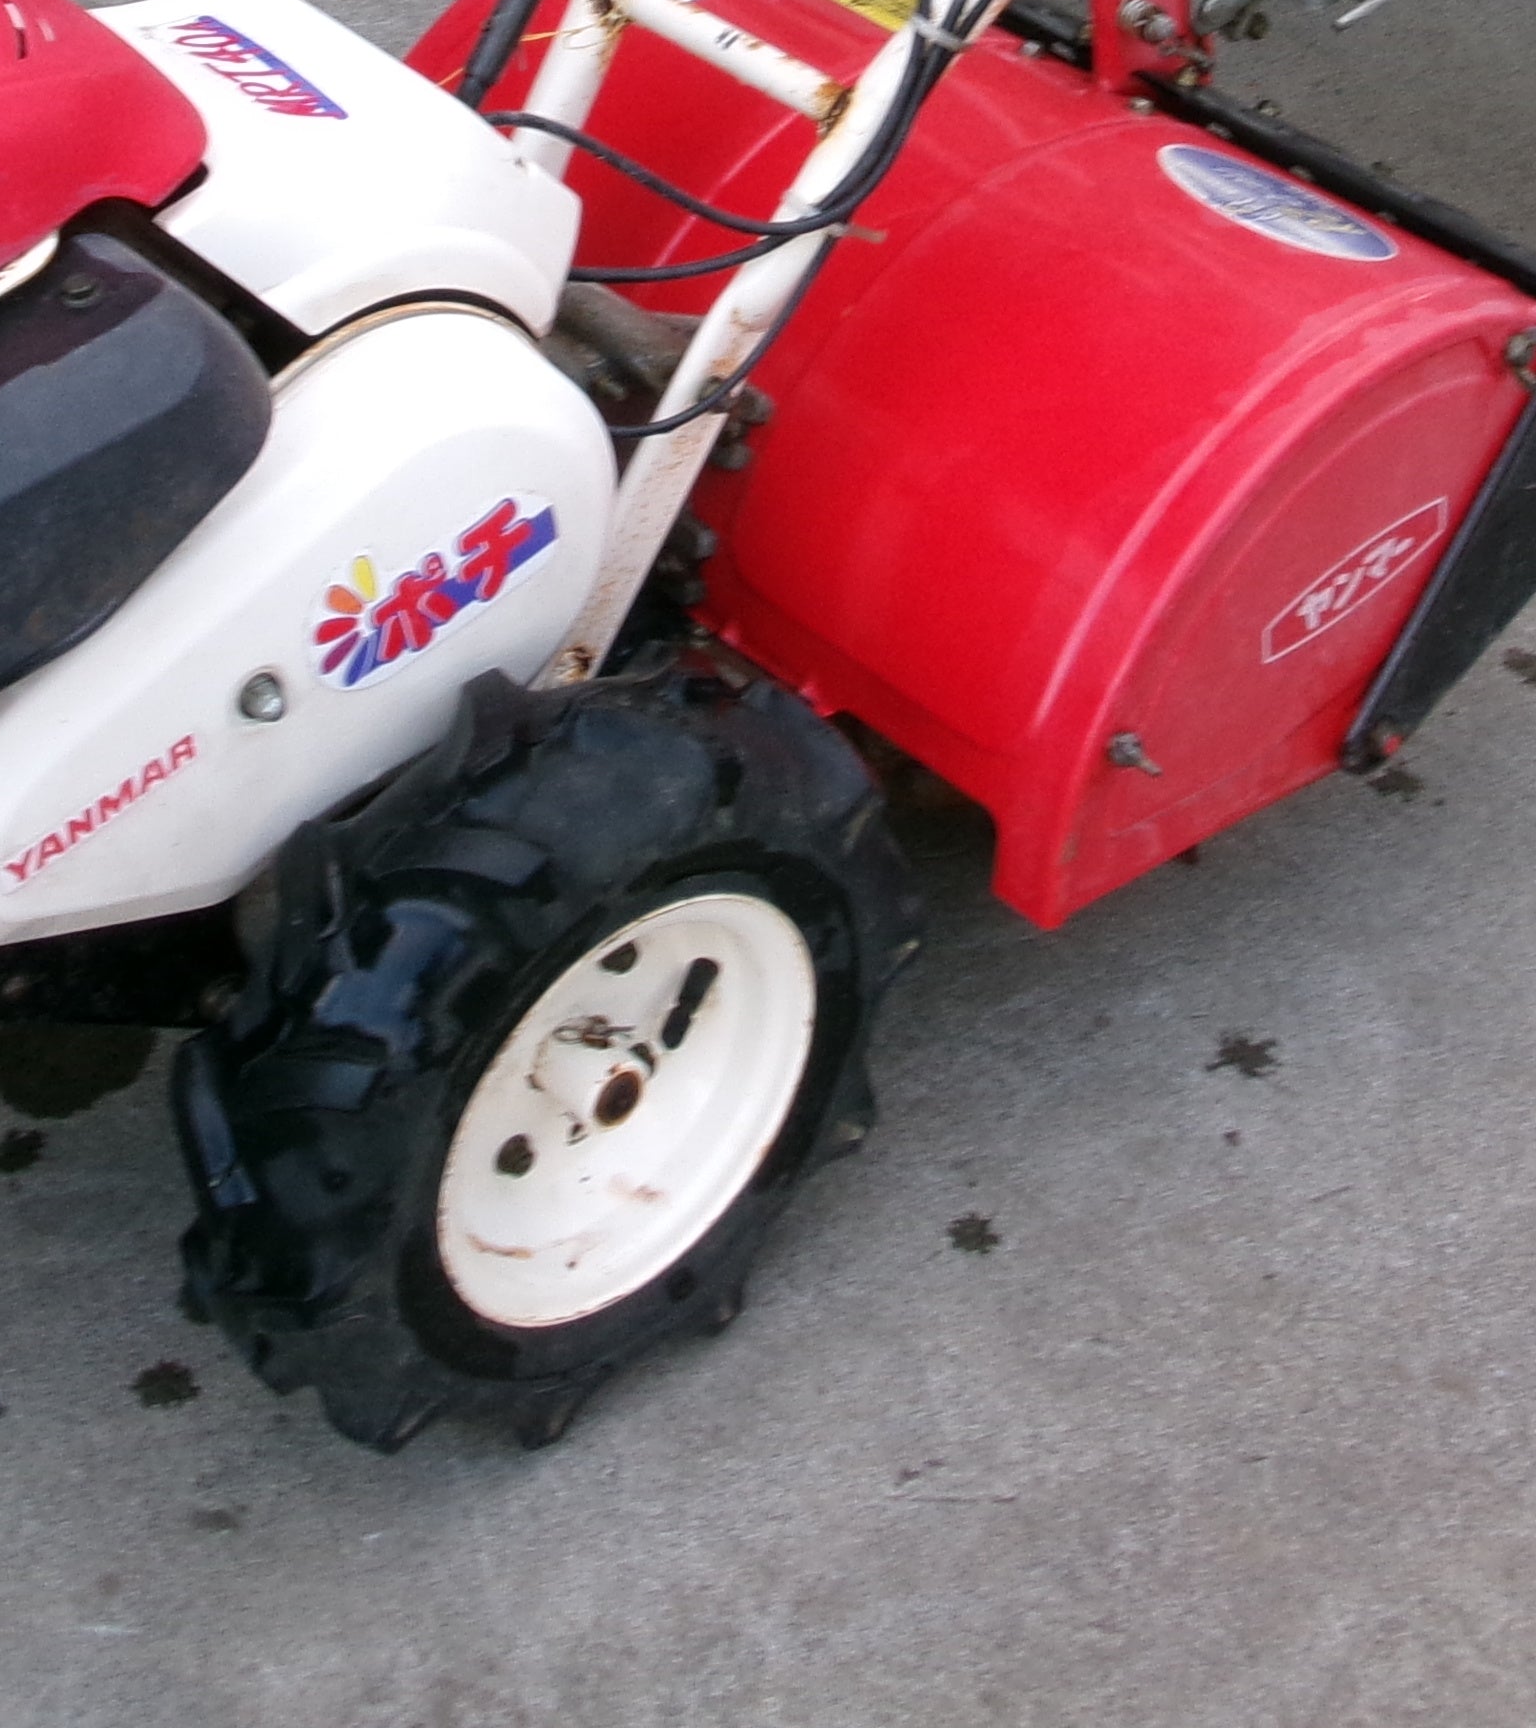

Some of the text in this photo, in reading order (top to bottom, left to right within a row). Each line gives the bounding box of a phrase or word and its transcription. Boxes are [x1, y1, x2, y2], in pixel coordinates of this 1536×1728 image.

[370, 499, 533, 664] ポチ
[1296, 536, 1415, 631] ヤンマー
[4, 734, 196, 881] YANMAR
